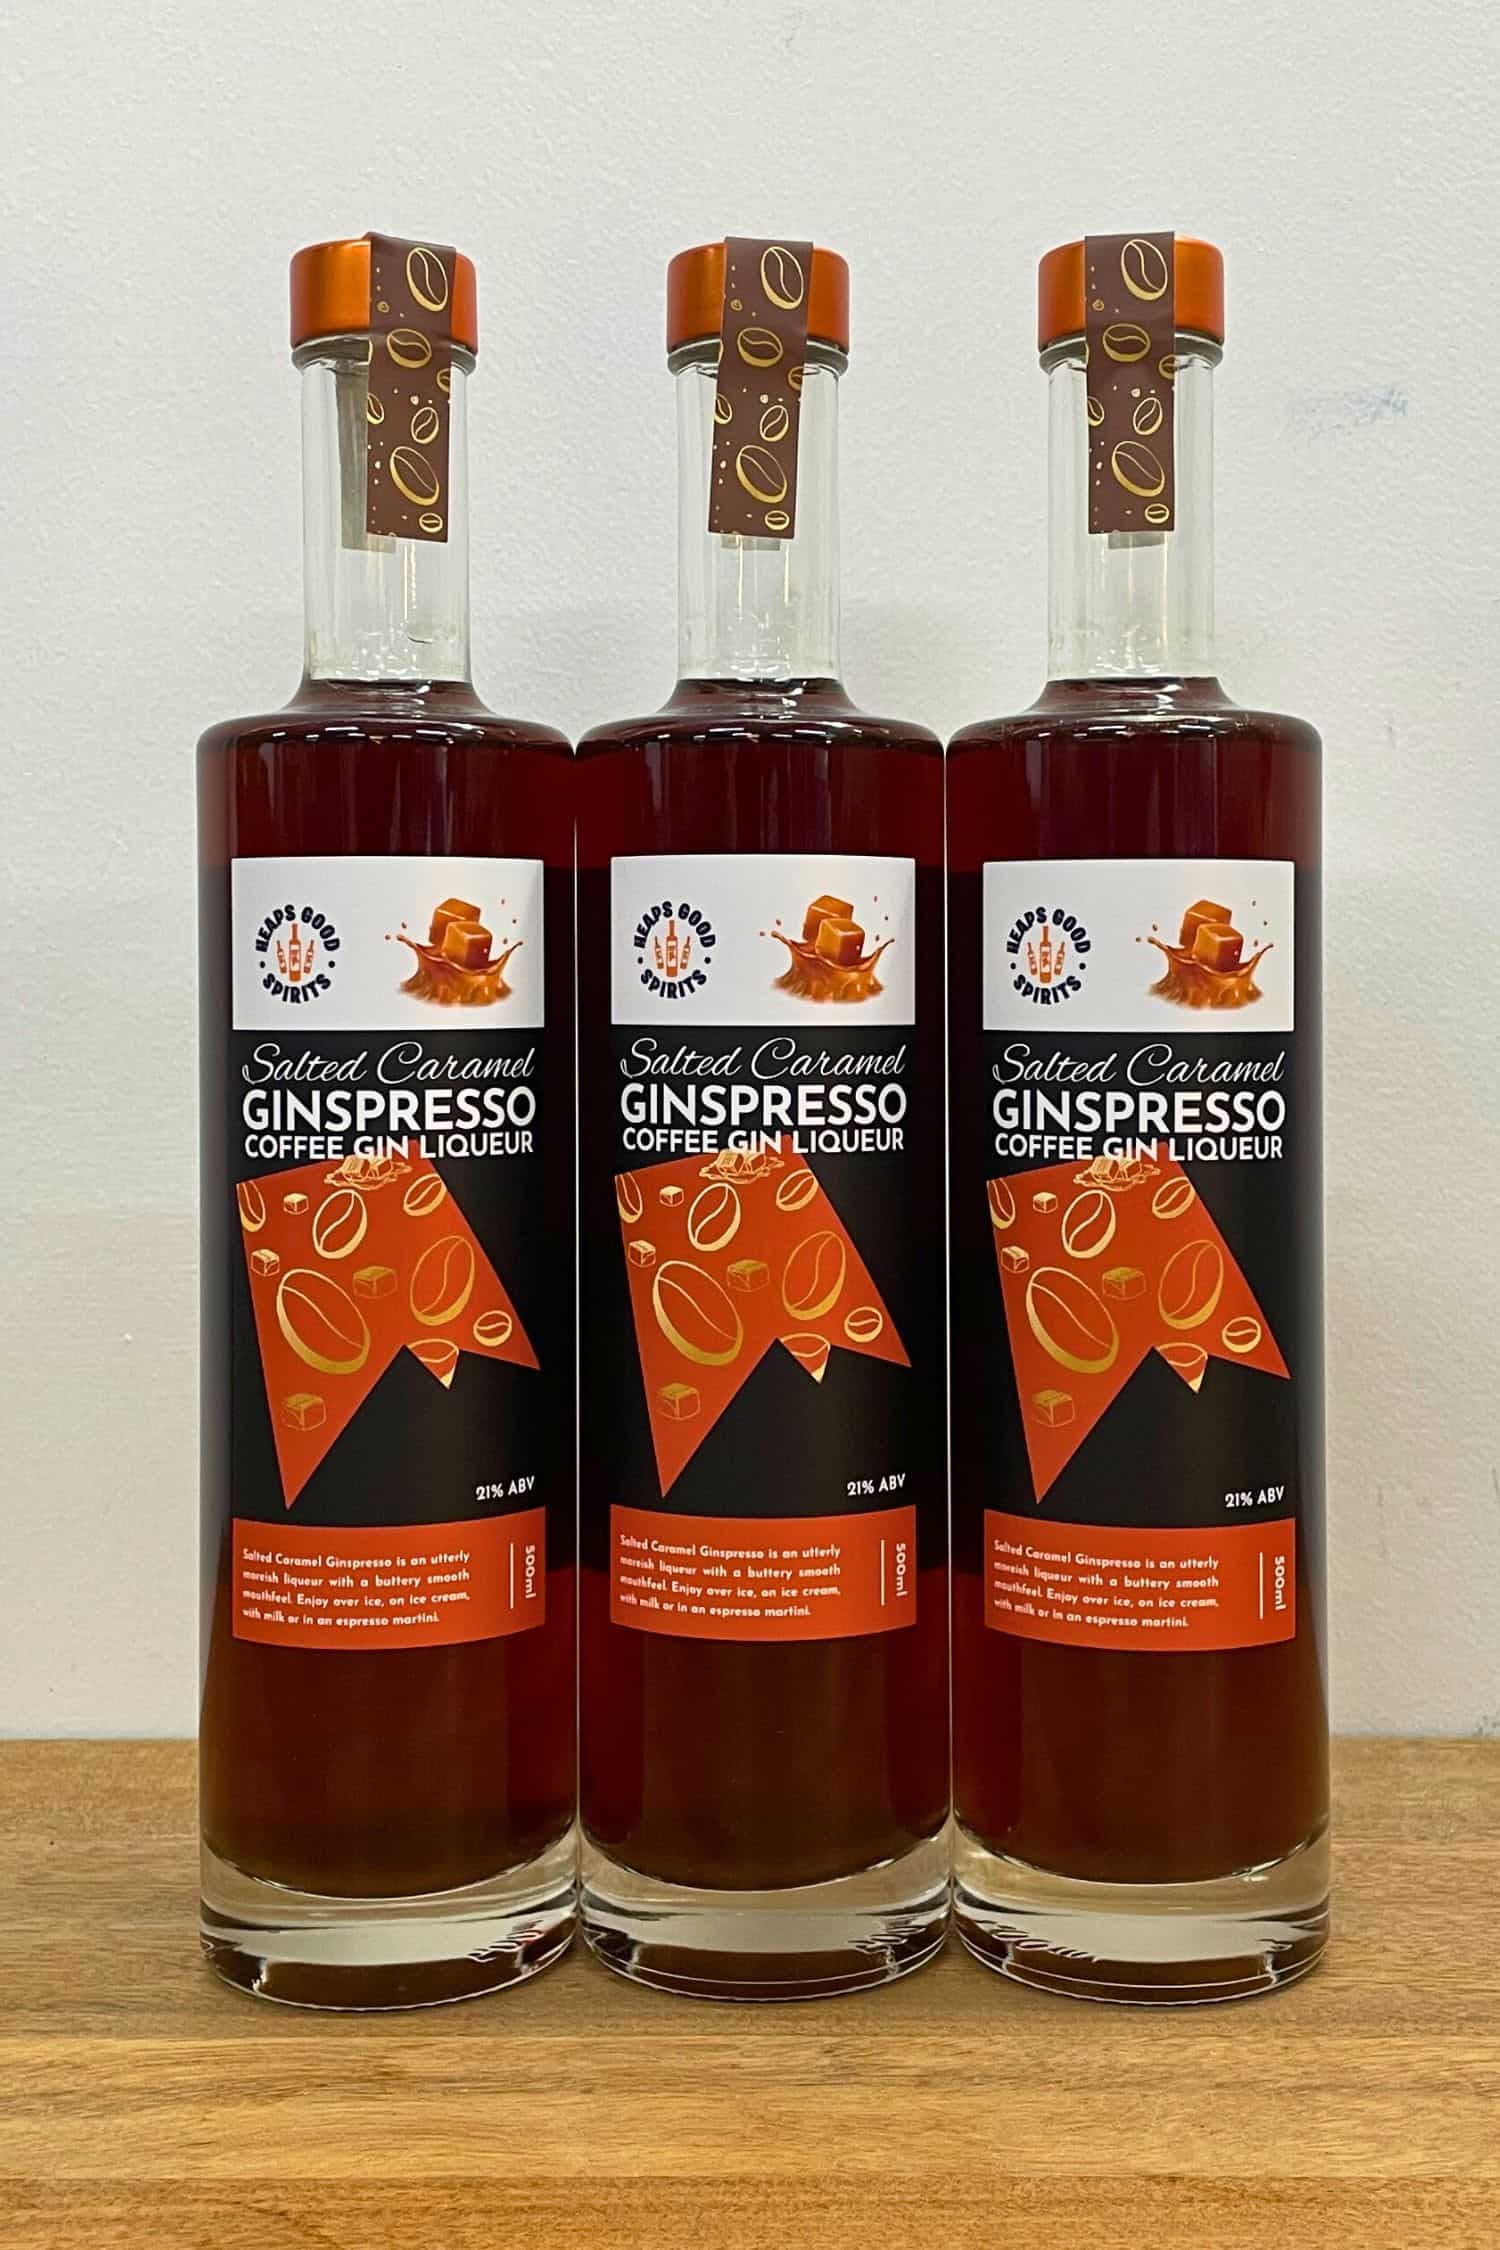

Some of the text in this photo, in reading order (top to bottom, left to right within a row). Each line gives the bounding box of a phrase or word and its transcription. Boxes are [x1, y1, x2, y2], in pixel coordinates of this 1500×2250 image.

[256, 904, 340, 953] HEAPS GOOD
[634, 901, 716, 949] HEAPS GOOD
[1006, 906, 1091, 953] HEAPS GOOD
[263, 973, 331, 1003] SPIRITS
[641, 969, 706, 998] SPIRITS
[1013, 975, 1081, 1005] SPIRITS
[242, 1041, 535, 1085] Salted Caramel
[620, 1037, 906, 1079] Salted Caramel
[992, 1043, 1285, 1086] Salted Caramel
[242, 1086, 536, 1132] GINSPRESSO
[620, 1083, 907, 1127] GINSPRESSO
[992, 1089, 1286, 1133] GINSPRESSO
[245, 1131, 533, 1159] COFFEE GIN LIQUEUR
[623, 1127, 904, 1153] COFFEE GIN LIQUEUR
[995, 1133, 1283, 1161] COFFEE GIN LIQUEUR
[475, 1476, 535, 1501] 21% ABV
[847, 1474, 906, 1495] 21% ABV
[1225, 1486, 1284, 1508] 21% ABV
[242, 1548, 470, 1570] Salted Caramel Ginspresso is an utterly
[620, 1534, 648, 1550] Salted
[651, 1540, 696, 1556] Caramel
[700, 1546, 764, 1560] Ginspresso
[768, 1548, 778, 1559] is
[802, 1544, 840, 1559] utterly
[994, 1539, 1218, 1570] Salted Caramel Ginspresso is an utterly
[284, 1572, 323, 1588] liqueur
[329, 1576, 353, 1587] with
[360, 1579, 368, 1587] a
[376, 1575, 421, 1588] buttery
[427, 1568, 469, 1583] smooth
[524, 1545, 536, 1598] 500ml
[659, 1560, 697, 1576] liqueur
[703, 1565, 727, 1577] with
[733, 1569, 741, 1578] a
[748, 1566, 792, 1580] buttery
[799, 1563, 840, 1577] smooth
[896, 1543, 907, 1597] 500ml
[1034, 1566, 1072, 1582] liqueur
[1078, 1574, 1103, 1585] with
[1109, 1578, 1118, 1586] a
[1124, 1576, 1170, 1590] buttery
[1176, 1576, 1219, 1588] smooth
[1274, 1556, 1286, 1610] 500ml
[297, 1593, 328, 1608] Enjoy
[333, 1596, 359, 1607] over
[389, 1597, 404, 1606] on
[410, 1595, 426, 1605] ice
[672, 1581, 702, 1597] Enjoy
[707, 1589, 732, 1597] over
[761, 1589, 776, 1597] on
[781, 1587, 798, 1597] ice
[1047, 1588, 1078, 1605] Enjoy
[1083, 1594, 1109, 1606] over
[1138, 1599, 1154, 1607] on
[1158, 1597, 1175, 1608] ice
[242, 1608, 261, 1619] with
[264, 1610, 284, 1622] milk
[288, 1615, 299, 1623] or
[303, 1614, 313, 1624] in
[317, 1618, 332, 1626] an
[336, 1615, 388, 1627] espresso
[620, 1594, 638, 1605] with
[640, 1597, 660, 1609] milk
[663, 1602, 674, 1611] or
[677, 1602, 687, 1612] in
[691, 1605, 705, 1614] an
[710, 1605, 761, 1618] espresso
[994, 1599, 1012, 1610] with
[1014, 1603, 1035, 1616] milk
[1038, 1609, 1050, 1617] or
[1053, 1609, 1063, 1620] in
[1067, 1614, 1082, 1623] an
[1085, 1613, 1137, 1627] espresso
